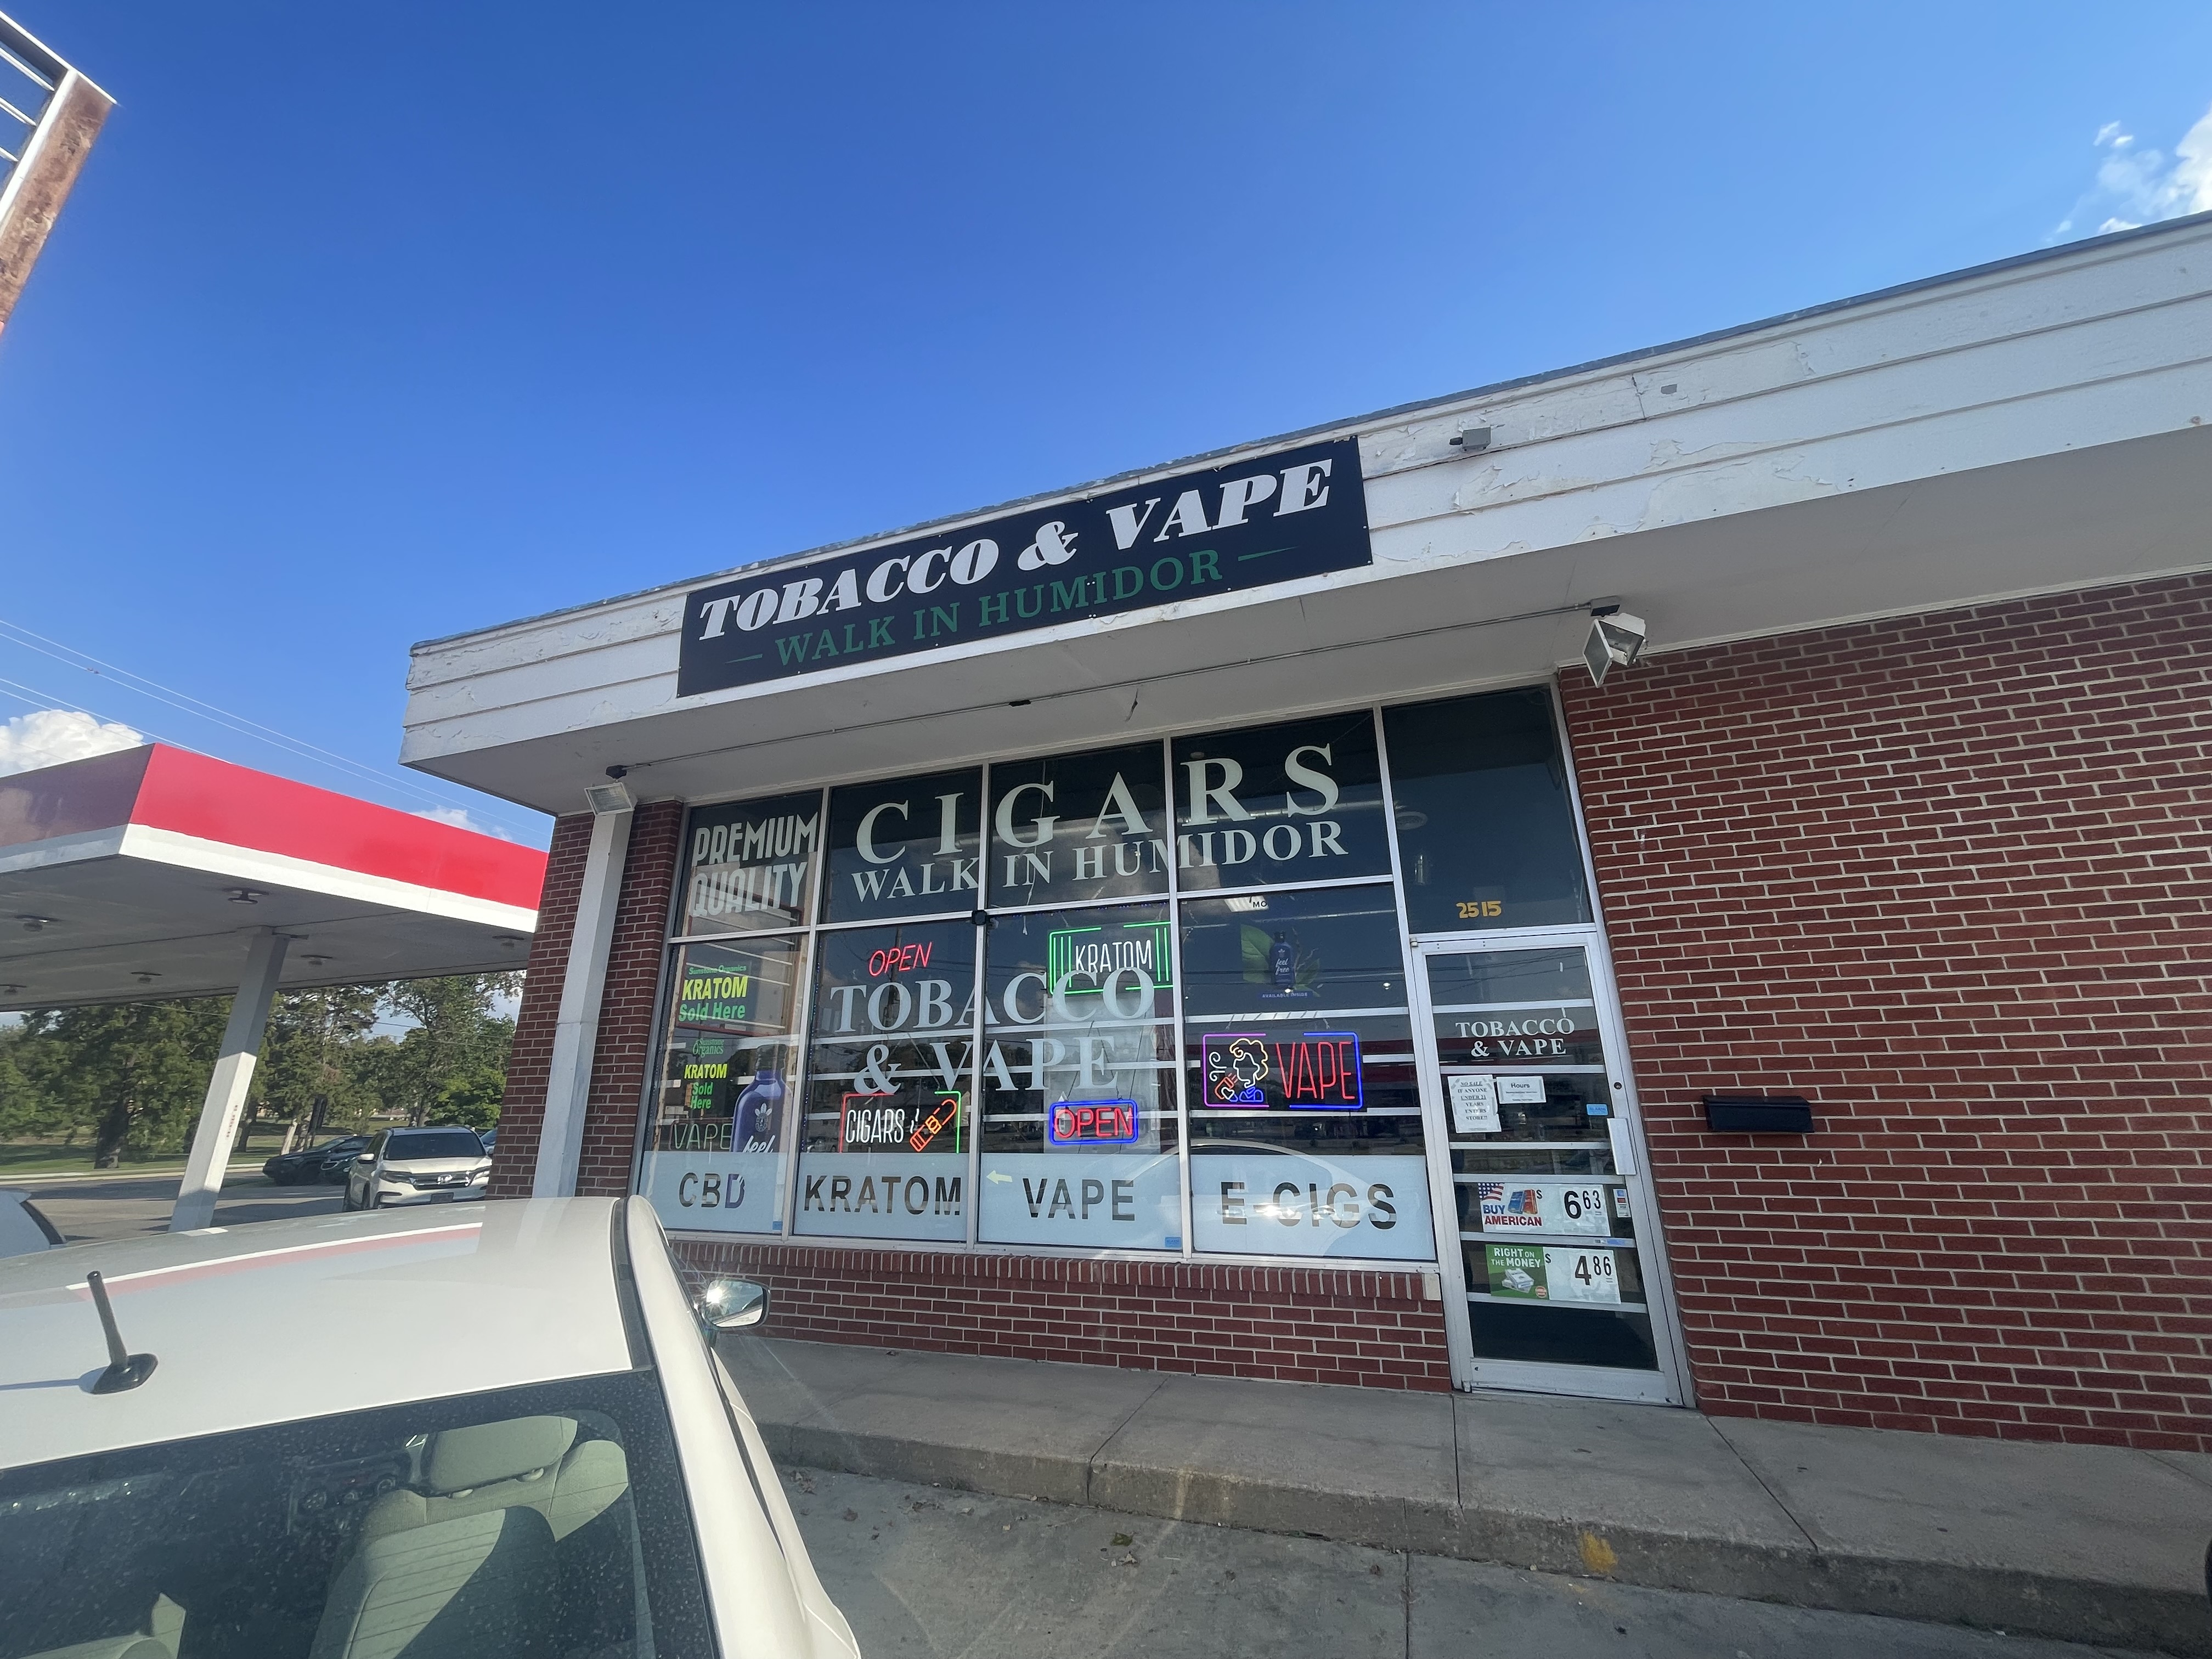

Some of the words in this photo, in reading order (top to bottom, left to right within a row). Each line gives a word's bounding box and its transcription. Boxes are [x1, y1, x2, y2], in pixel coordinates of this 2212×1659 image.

[698, 538, 1000, 641] TOBACCO
[1017, 521, 1079, 571] &
[1105, 458, 1333, 550] VAPE
[775, 616, 895, 666] WALK
[913, 602, 960, 640] IN
[978, 549, 1222, 628] HUMIDOR
[856, 742, 1339, 865] CIGARS
[692, 811, 819, 867] PREMIUM
[851, 856, 979, 902] WALK
[1002, 850, 1053, 888] IN
[1071, 820, 1349, 882] HUMIDOR
[691, 861, 808, 917] QUALITY
[1455, 900, 1502, 918] 2515
[867, 941, 933, 977] OPEN
[1075, 939, 1152, 974] KRATOM
[1276, 958, 1289, 967] feel
[1276, 966, 1289, 975] free
[682, 975, 748, 1001] KRATOM
[830, 967, 1154, 1033] TOBACCO
[678, 1002, 709, 1022] Sold
[712, 1002, 746, 1020] Here
[1455, 1017, 1576, 1038] TOBACCO
[693, 1040, 725, 1058] Organics
[1470, 1040, 1489, 1058] &
[1497, 1037, 1566, 1056] VAPE
[684, 1063, 728, 1079] KRATOM
[853, 1043, 901, 1096] &
[929, 1035, 1119, 1092] VAPE
[1275, 1041, 1356, 1100] VAPE
[690, 1095, 712, 1110] Here
[692, 1082, 714, 1096] Sold
[674, 1123, 732, 1150] VAPE
[845, 1108, 905, 1144] CIGARS
[1053, 1106, 1135, 1139] OPEN
[678, 1172, 746, 1209] CBD
[804, 1175, 962, 1216] KRATOM
[1022, 1177, 1136, 1221] VAPE
[1220, 1181, 1397, 1230] E-CIGS
[1483, 1204, 1506, 1215] BUY
[1484, 1215, 1543, 1227] AMERICAN
[1493, 1248, 1524, 1258] RIGHT
[1524, 1250, 1536, 1259] ON
[1505, 1256, 1541, 1268] MONEY
